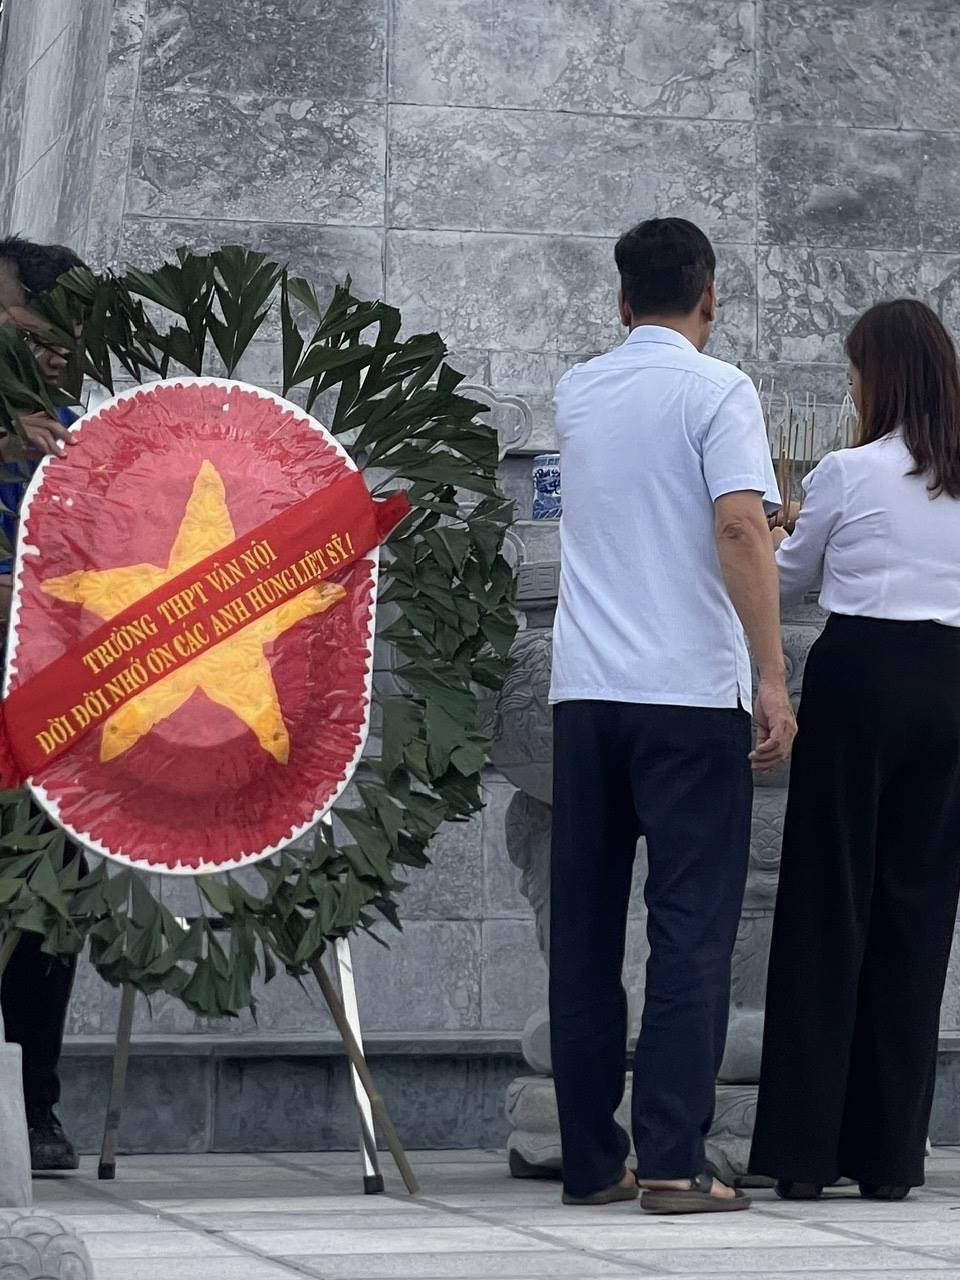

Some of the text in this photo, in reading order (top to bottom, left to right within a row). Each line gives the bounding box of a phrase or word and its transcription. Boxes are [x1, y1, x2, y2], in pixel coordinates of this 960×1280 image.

[35, 715, 76, 755] ĐỜI
[70, 689, 112, 728] ĐỜI
[104, 656, 148, 702] NHỚ
[146, 643, 177, 674] ƠN
[173, 622, 210, 657] CÁC
[210, 597, 251, 636] ANH
[245, 569, 298, 612] HÙNG
[290, 549, 328, 585] LIỆT
[82, 539, 278, 674] TRƯỜNG THPT VÂN NỘI
